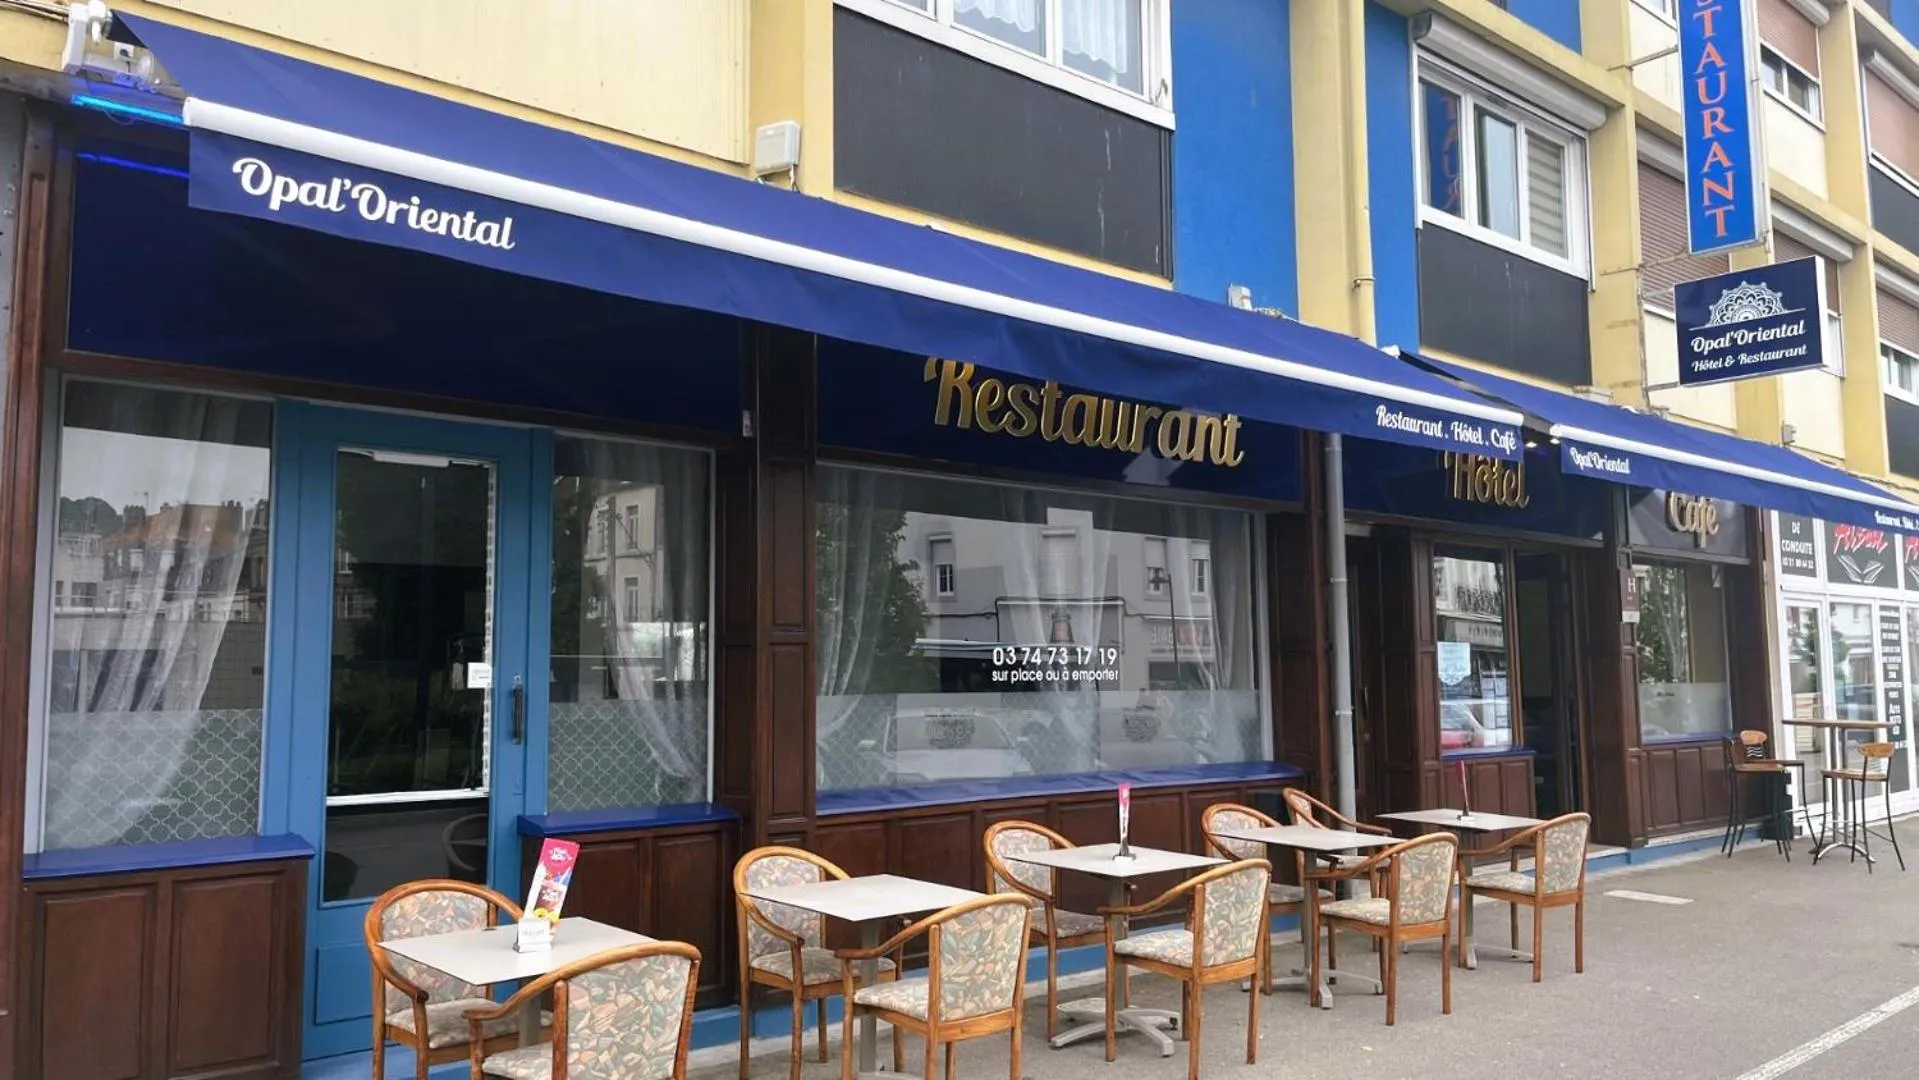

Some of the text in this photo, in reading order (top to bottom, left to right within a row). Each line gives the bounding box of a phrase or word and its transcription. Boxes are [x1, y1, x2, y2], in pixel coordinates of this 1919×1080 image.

[232, 157, 516, 250] Opal'Oriental
[1691, 320, 1806, 356] Opal'Oriental
[1691, 344, 1806, 373] Hôtel & Restaurant
[924, 356, 1246, 468] Restaurant
[1490, 428, 1517, 456] Café
[992, 646, 1118, 666] 03 74 73 17 19
[992, 667, 1119, 684] sur place ou à emporter
